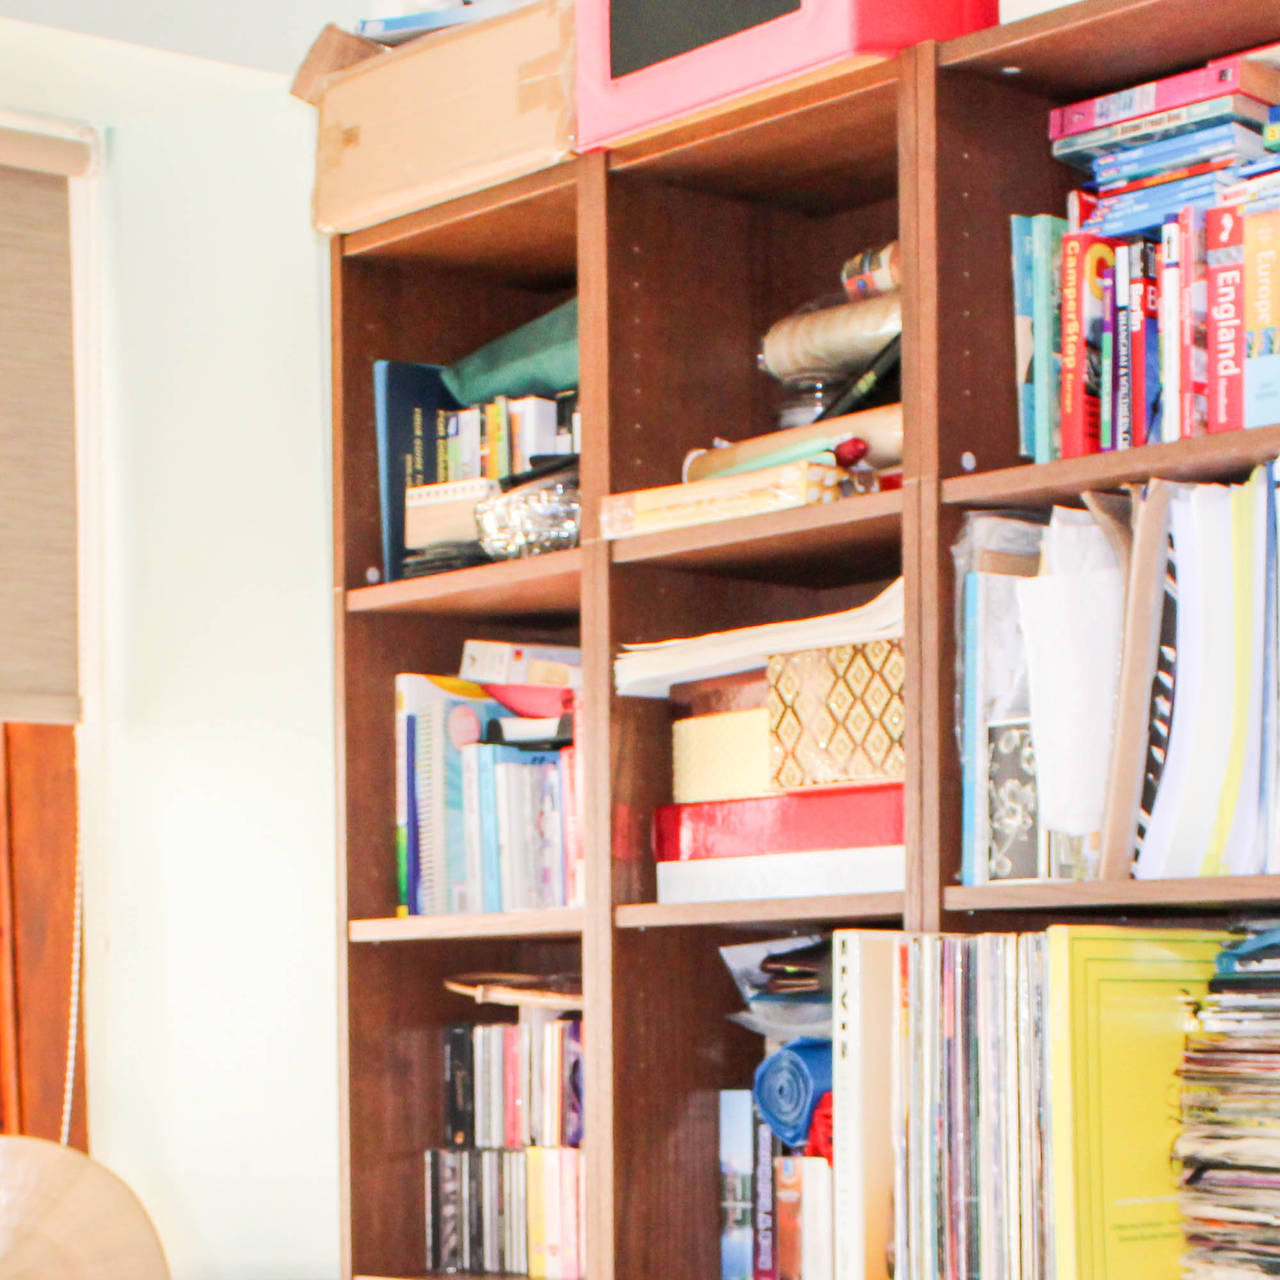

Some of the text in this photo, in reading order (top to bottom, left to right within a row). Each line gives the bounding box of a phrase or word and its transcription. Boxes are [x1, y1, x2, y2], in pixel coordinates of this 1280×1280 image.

[1062, 240, 1079, 368] CamperStop
[1213, 270, 1241, 377] England
[1253, 250, 1277, 325] Europe
